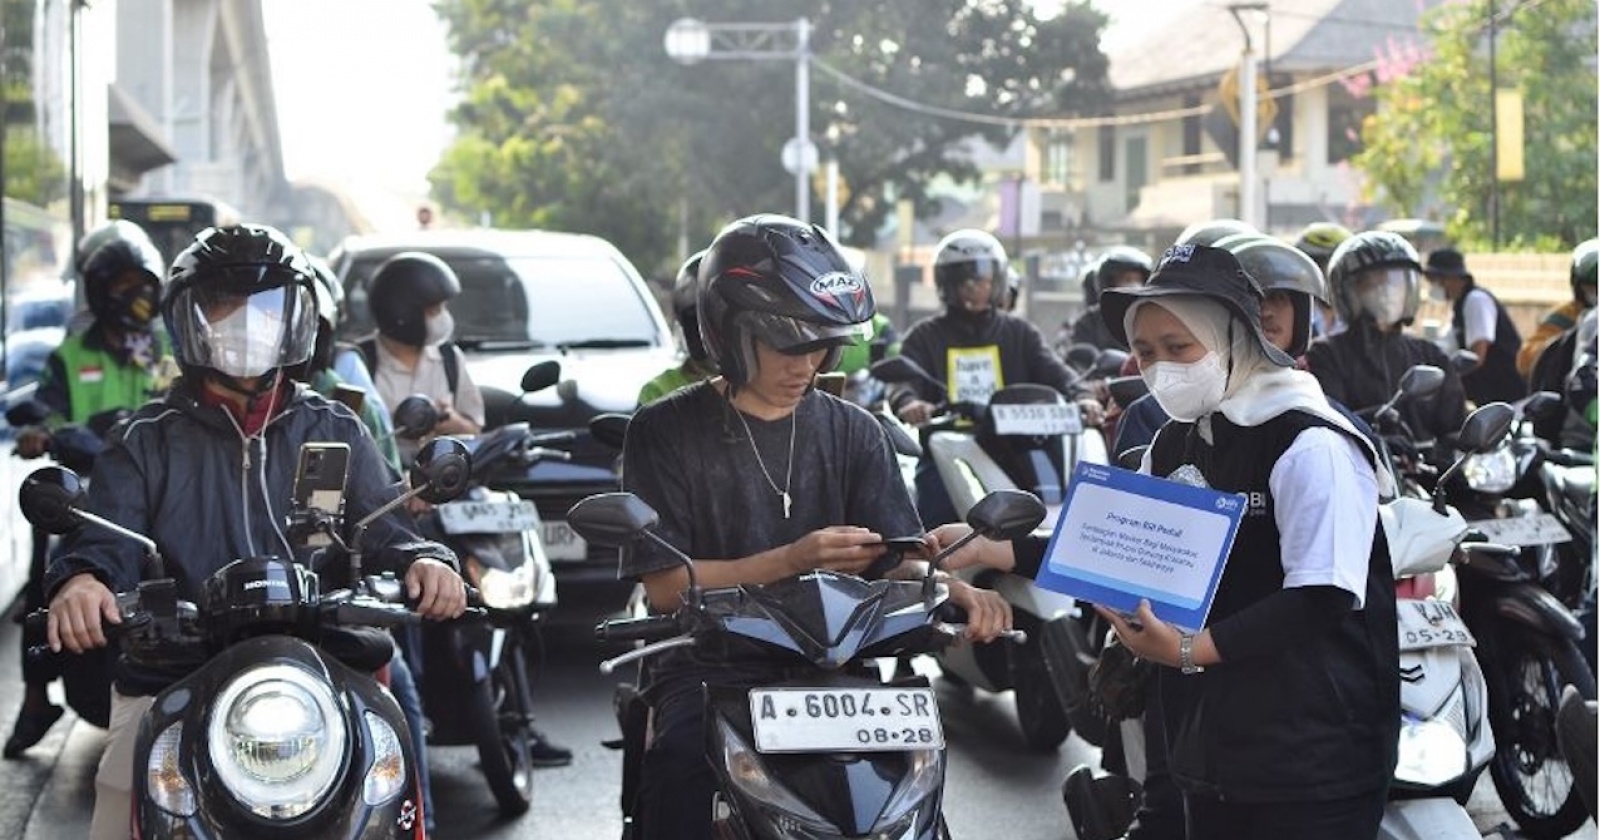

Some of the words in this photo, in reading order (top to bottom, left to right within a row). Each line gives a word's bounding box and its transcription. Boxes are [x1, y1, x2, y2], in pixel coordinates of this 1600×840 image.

[760, 694, 777, 720] A
[804, 692, 875, 718] 6004
[895, 692, 931, 717] SR
